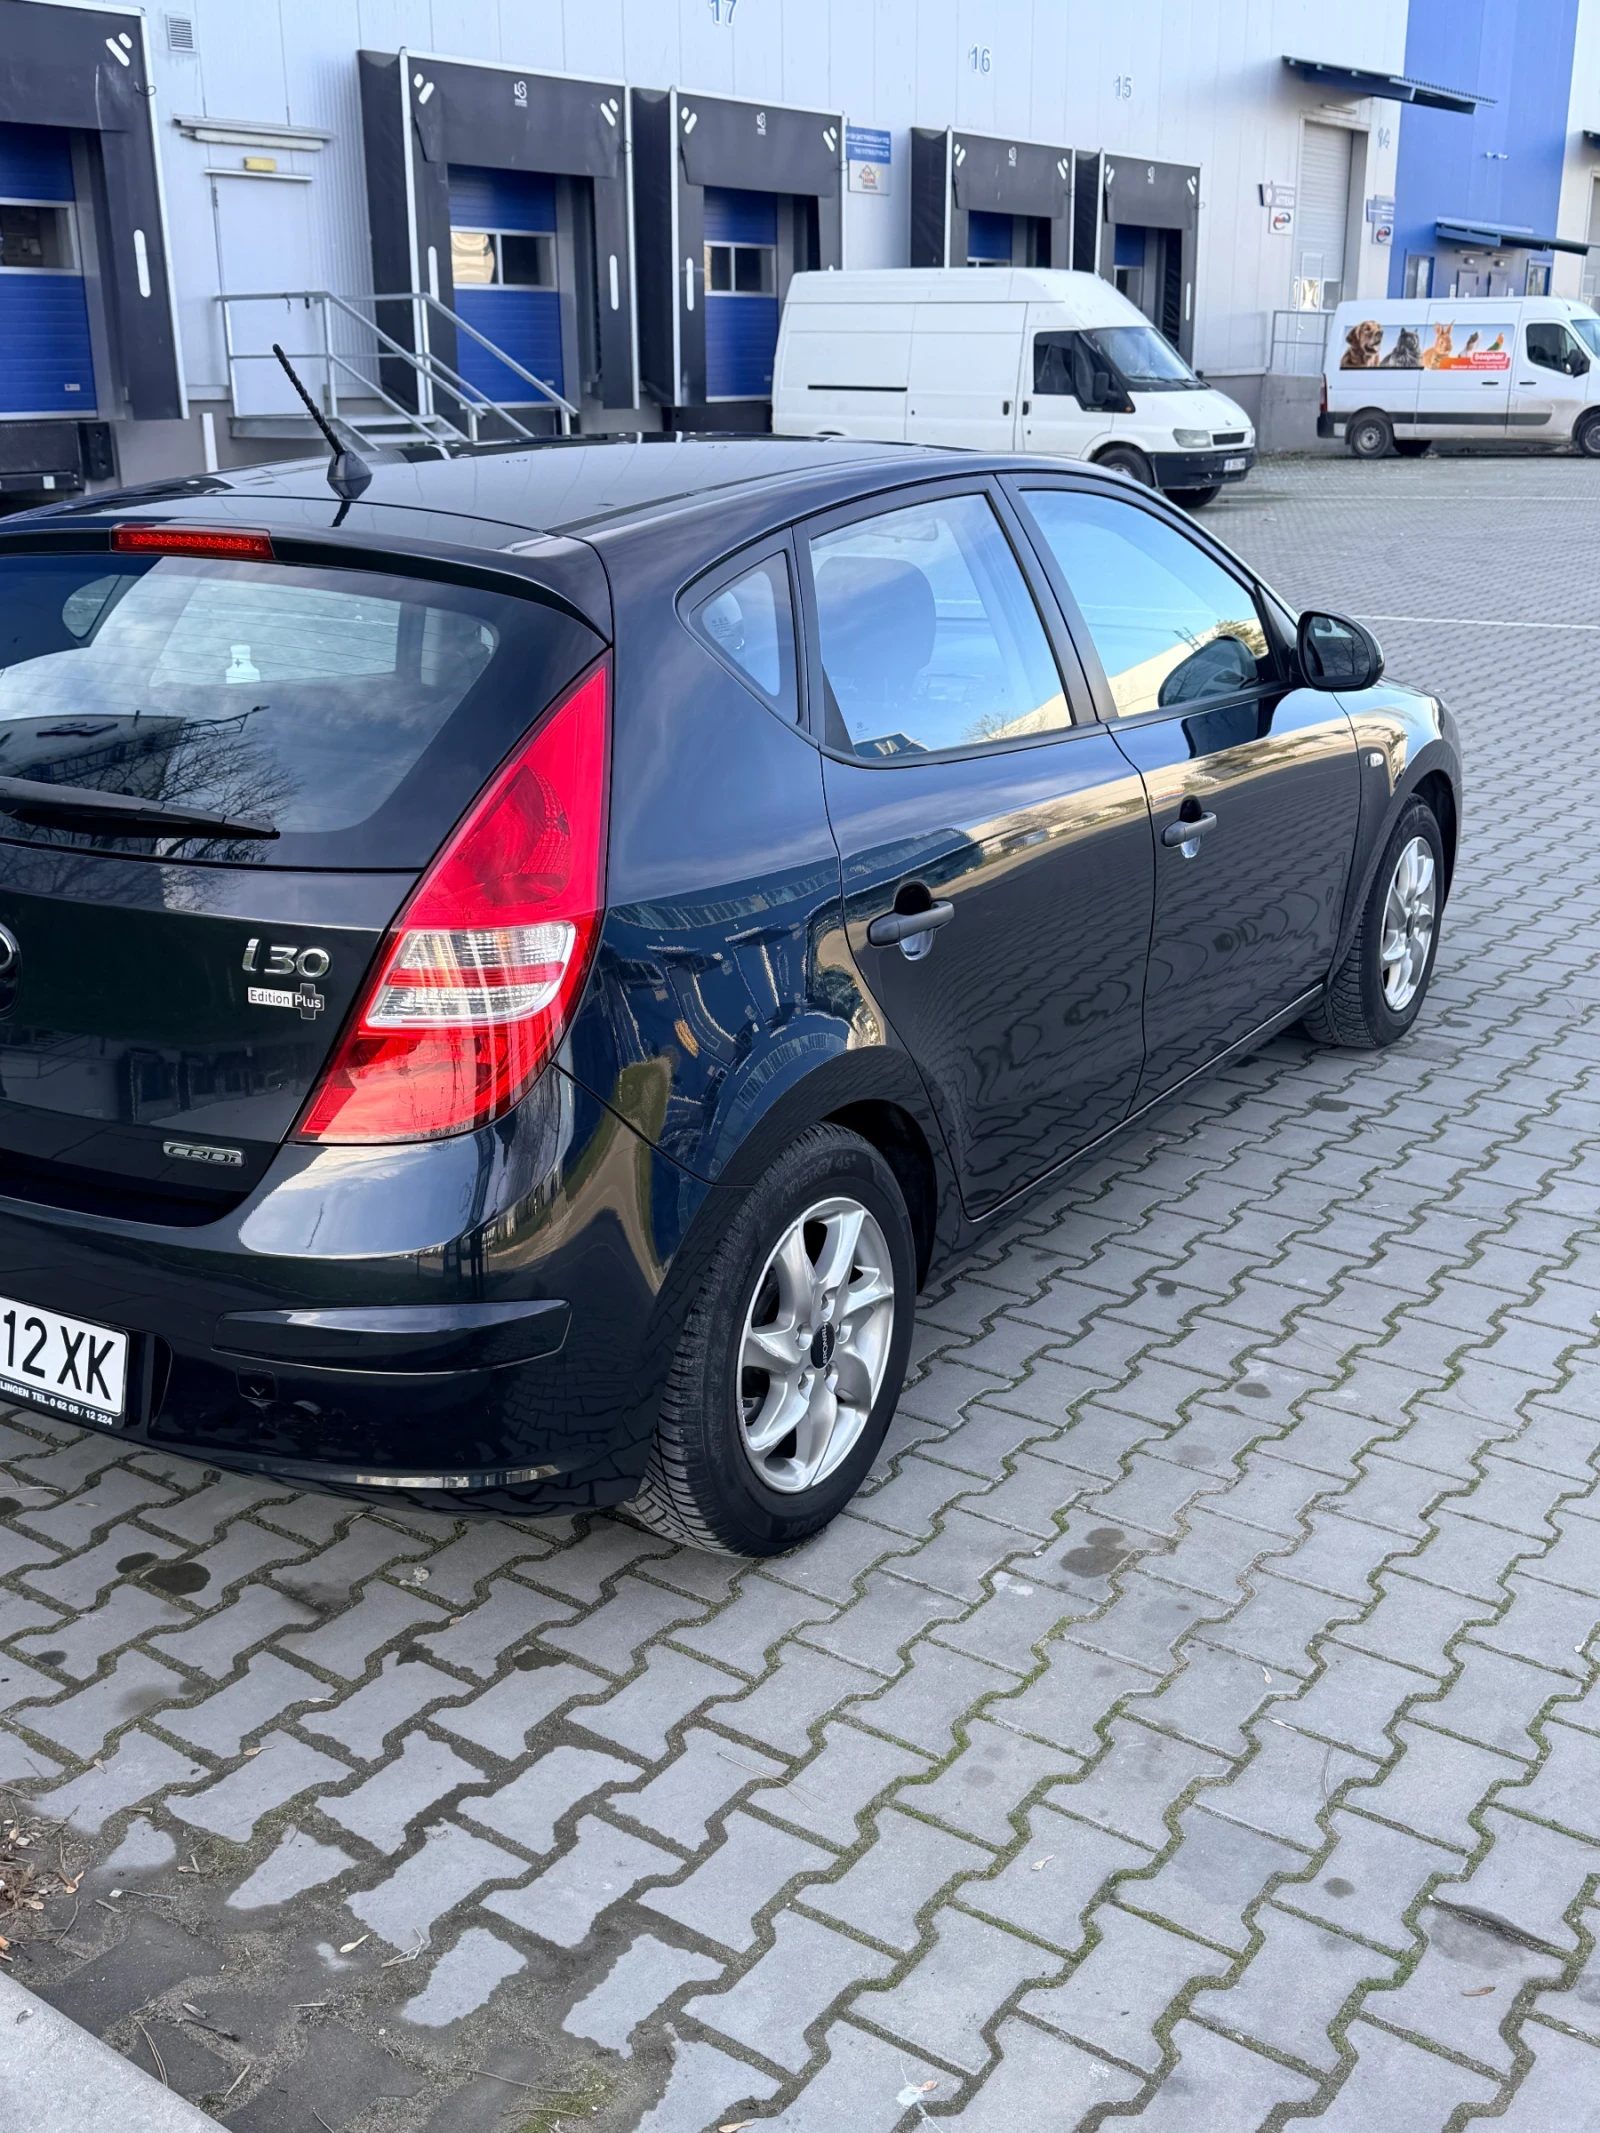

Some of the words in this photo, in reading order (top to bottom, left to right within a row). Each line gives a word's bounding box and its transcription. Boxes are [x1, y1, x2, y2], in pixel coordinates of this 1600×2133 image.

[709, 0, 738, 24] 17
[969, 45, 991, 73] 16
[1114, 75, 1132, 99] 15
[250, 989, 290, 1005] Edition
[294, 994, 321, 1008] Plus
[168, 1146, 238, 1163] CRDi
[3, 1309, 48, 1379] 12
[56, 1325, 115, 1401] XK
[0, 1381, 30, 1398] LINGEN
[31, 1391, 49, 1405] TEL.
[50, 1398, 56, 1407] 0
[57, 1400, 68, 1411] 62
[68, 1404, 79, 1415] 05
[86, 1410, 96, 1420] 12
[97, 1413, 112, 1425] 224
